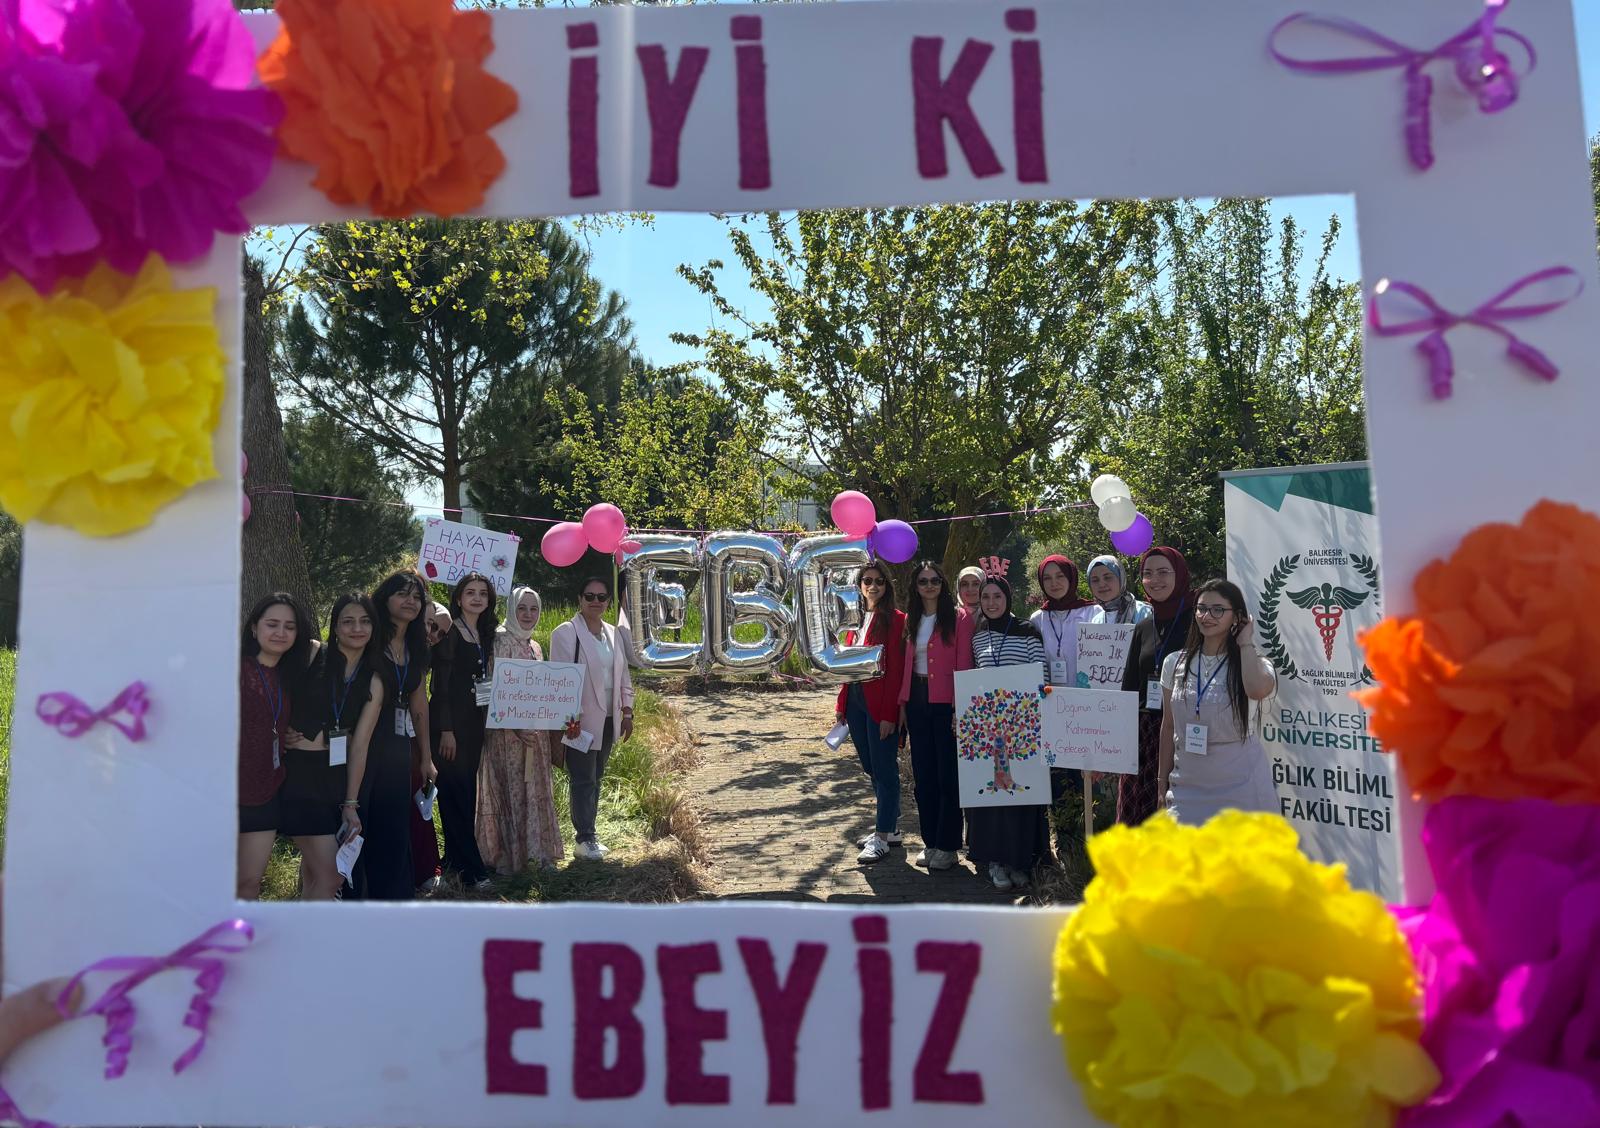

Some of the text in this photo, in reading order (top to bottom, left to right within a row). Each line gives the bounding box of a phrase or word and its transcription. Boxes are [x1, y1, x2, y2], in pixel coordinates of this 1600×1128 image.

[566, 8, 1049, 198] İYİ Kİ
[440, 528, 499, 552] HAYAT
[423, 543, 482, 570] EBEYLE
[1303, 556, 1348, 566] ÜNİVERSİTESİ
[1308, 548, 1343, 557] BALIKESİR
[446, 565, 506, 592] BAAR
[979, 555, 1010, 579] EBE
[620, 529, 885, 684] EBE
[525, 670, 541, 686] Bir
[1088, 664, 1123, 684] EBEL
[1301, 668, 1357, 680] SAĞLIK BİLİMLERİ
[1313, 678, 1347, 688] FAKÜLTESİ
[558, 691, 575, 703] eden
[1322, 688, 1339, 696] 1992
[507, 705, 560, 719] Mucize Eller
[1280, 708, 1368, 731] BALIKESİ
[1263, 723, 1385, 753] ÜNİVERSİTE
[1272, 757, 1394, 799] ĞLIK BİLİML
[1280, 797, 1391, 833] FAKÜLTESİ
[482, 914, 985, 1111] EBEYİZ
